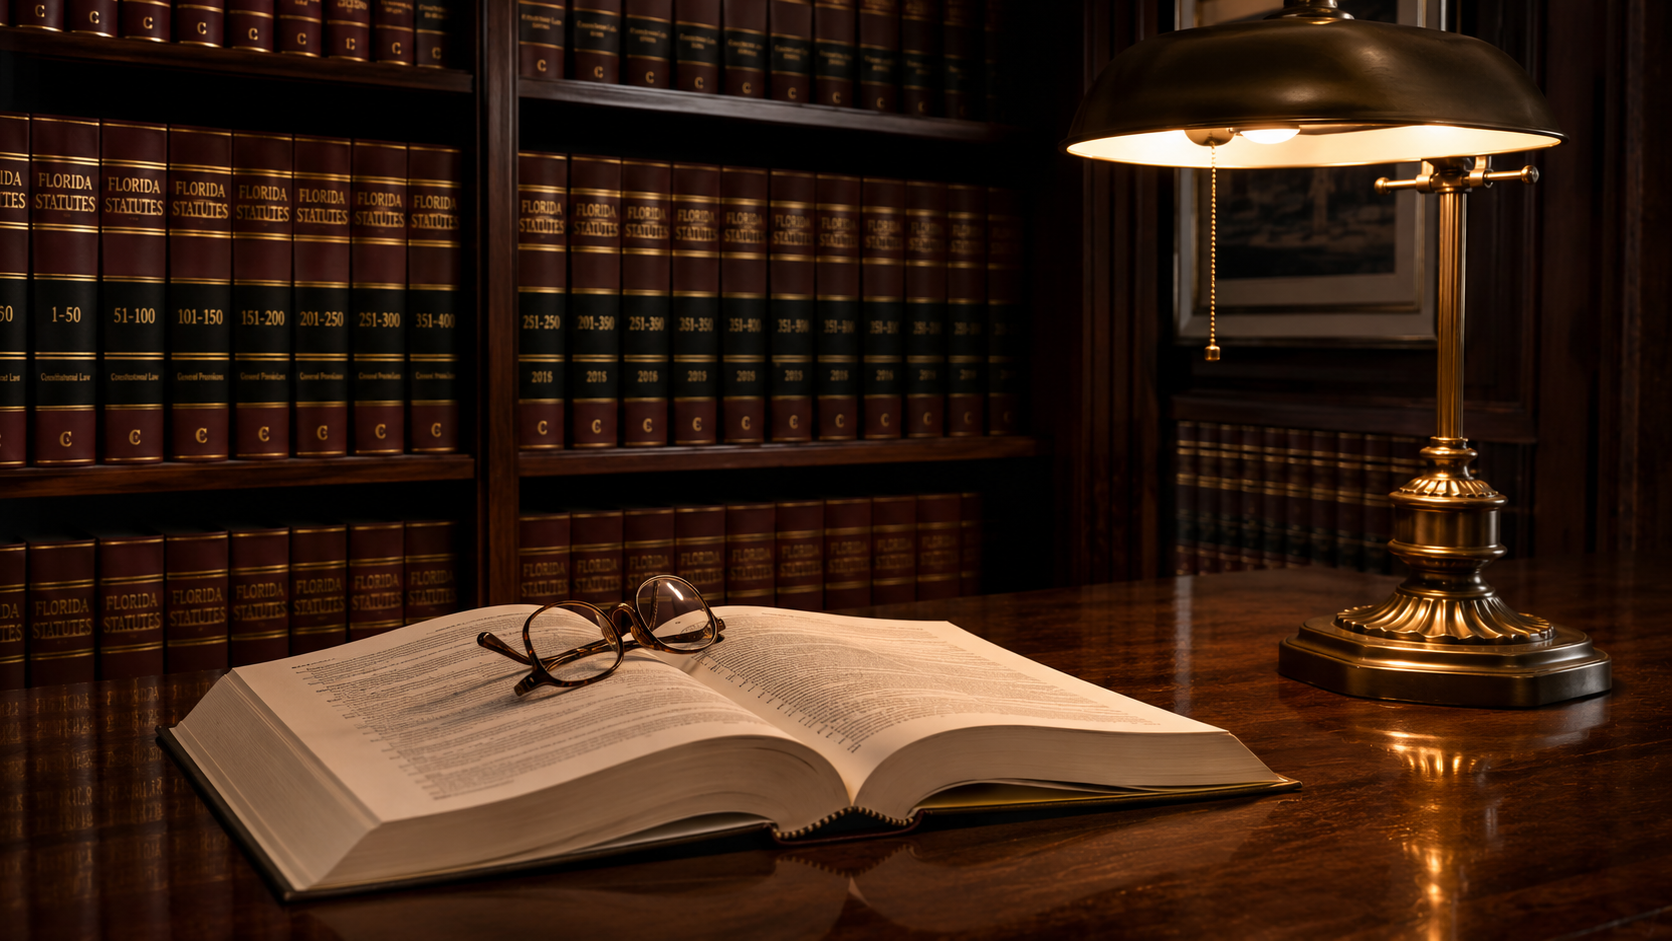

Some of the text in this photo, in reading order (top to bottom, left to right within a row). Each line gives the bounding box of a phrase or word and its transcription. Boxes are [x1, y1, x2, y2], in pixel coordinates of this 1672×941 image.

[35, 4, 45, 18] C
[89, 10, 100, 24] C
[142, 16, 153, 29] C
[196, 22, 207, 35] C
[248, 27, 258, 41] C
[297, 32, 307, 45] C
[392, 42, 401, 55] C
[536, 59, 547, 72] C
[594, 66, 604, 79] C
[645, 71, 655, 84] C
[694, 76, 704, 90] C
[742, 82, 752, 94] C
[787, 87, 797, 100] C
[832, 92, 841, 104] C
[0, 170, 22, 186] IDA
[38, 172, 93, 190] FLORIDA
[108, 176, 161, 194] FLORIDA
[175, 181, 226, 198] FLORIDA
[239, 184, 288, 202] FLORIDA
[299, 188, 345, 204] FLORIDA
[35, 194, 96, 212] STATUTES
[105, 197, 163, 216] STATUTES
[357, 191, 402, 208] FLORIDA
[414, 194, 458, 210] FLORIDA
[172, 201, 229, 219] STATUTES
[236, 205, 290, 222] STATUTES
[521, 200, 562, 216] FLORIDA
[576, 202, 616, 218] FLORIDA
[627, 206, 666, 221] FLORIDA
[677, 208, 715, 223] FLORIDA
[297, 208, 348, 225] STATUTES
[355, 211, 405, 228] STATUTES
[411, 213, 460, 230] STATUTES
[726, 211, 763, 226] FLORIDA
[519, 218, 564, 234] STATUTES
[574, 220, 619, 237] STATUTES
[625, 223, 669, 240] STATUTES
[675, 226, 718, 242] STATUTES
[724, 228, 766, 244] STATUTES
[52, 306, 81, 323] 1-50
[113, 307, 156, 324] 51-100
[177, 309, 223, 325] 101-150
[241, 310, 285, 327] 151-200
[300, 311, 344, 327] 201-250
[359, 312, 400, 327] 251-300
[415, 313, 456, 328] 351-400
[522, 315, 561, 330] 251-250
[79, 372, 91, 382] Law
[148, 372, 159, 381] Law
[880, 412, 890, 427] C
[923, 411, 932, 426] C
[523, 561, 566, 577] FLORIDA
[577, 558, 618, 574] FLORIDA
[296, 578, 342, 594] FLORIDA
[354, 573, 399, 590] FLORIDA
[410, 570, 454, 586] FLORIDA
[574, 575, 621, 594] STATUTES
[172, 587, 223, 605] FLORIDA
[236, 582, 284, 600] FLORIDA
[521, 579, 568, 597] STATUTES
[106, 592, 158, 611] FLORIDA
[352, 591, 402, 611] STATUTES
[408, 588, 457, 606] STATUTES
[35, 598, 89, 616] FLORIDA
[233, 600, 287, 621] STATUTES
[294, 596, 345, 616] STATUTES
[103, 612, 161, 634] STATUTES
[169, 606, 225, 627] STATUTES
[32, 618, 92, 640] STATUTES
